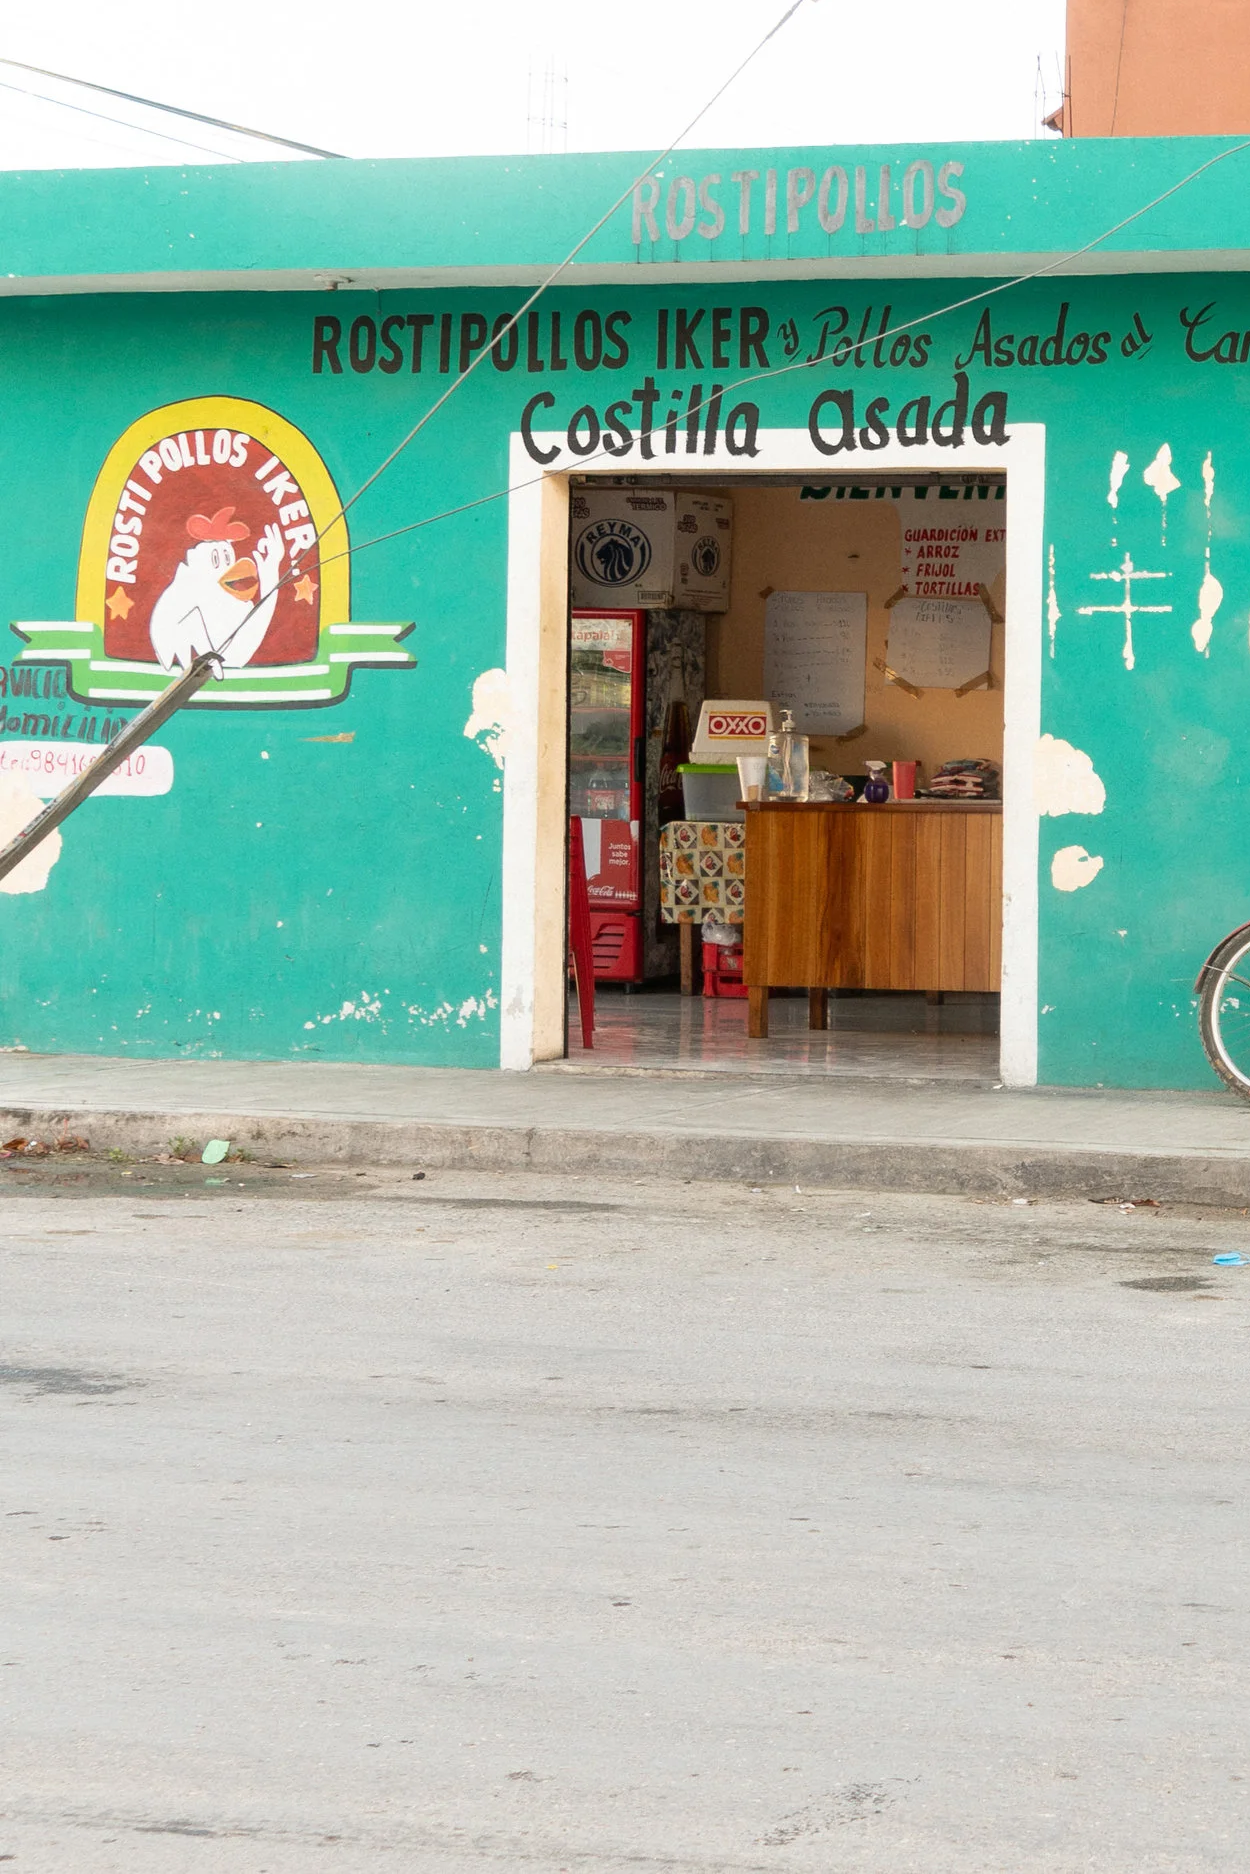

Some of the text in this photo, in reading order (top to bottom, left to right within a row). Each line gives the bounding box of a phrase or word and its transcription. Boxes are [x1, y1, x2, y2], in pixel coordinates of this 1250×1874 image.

[631, 159, 966, 245] ROSTIPOLLOS
[312, 309, 633, 375] ROSTIPOLLOS
[656, 306, 770, 369] IKER
[806, 304, 933, 369] Pollos
[954, 301, 1112, 371] Asados
[520, 376, 763, 465] Costilla
[106, 478, 153, 584] ROSTI
[138, 429, 251, 485] POLLOS
[586, 521, 641, 548] REYMA
[916, 545, 960, 559] ARROZ
[916, 563, 956, 577] FRIJOL
[915, 581, 981, 596] TORTILLAS
[710, 716, 766, 736] OXXO
[608, 843, 631, 851] Juntos
